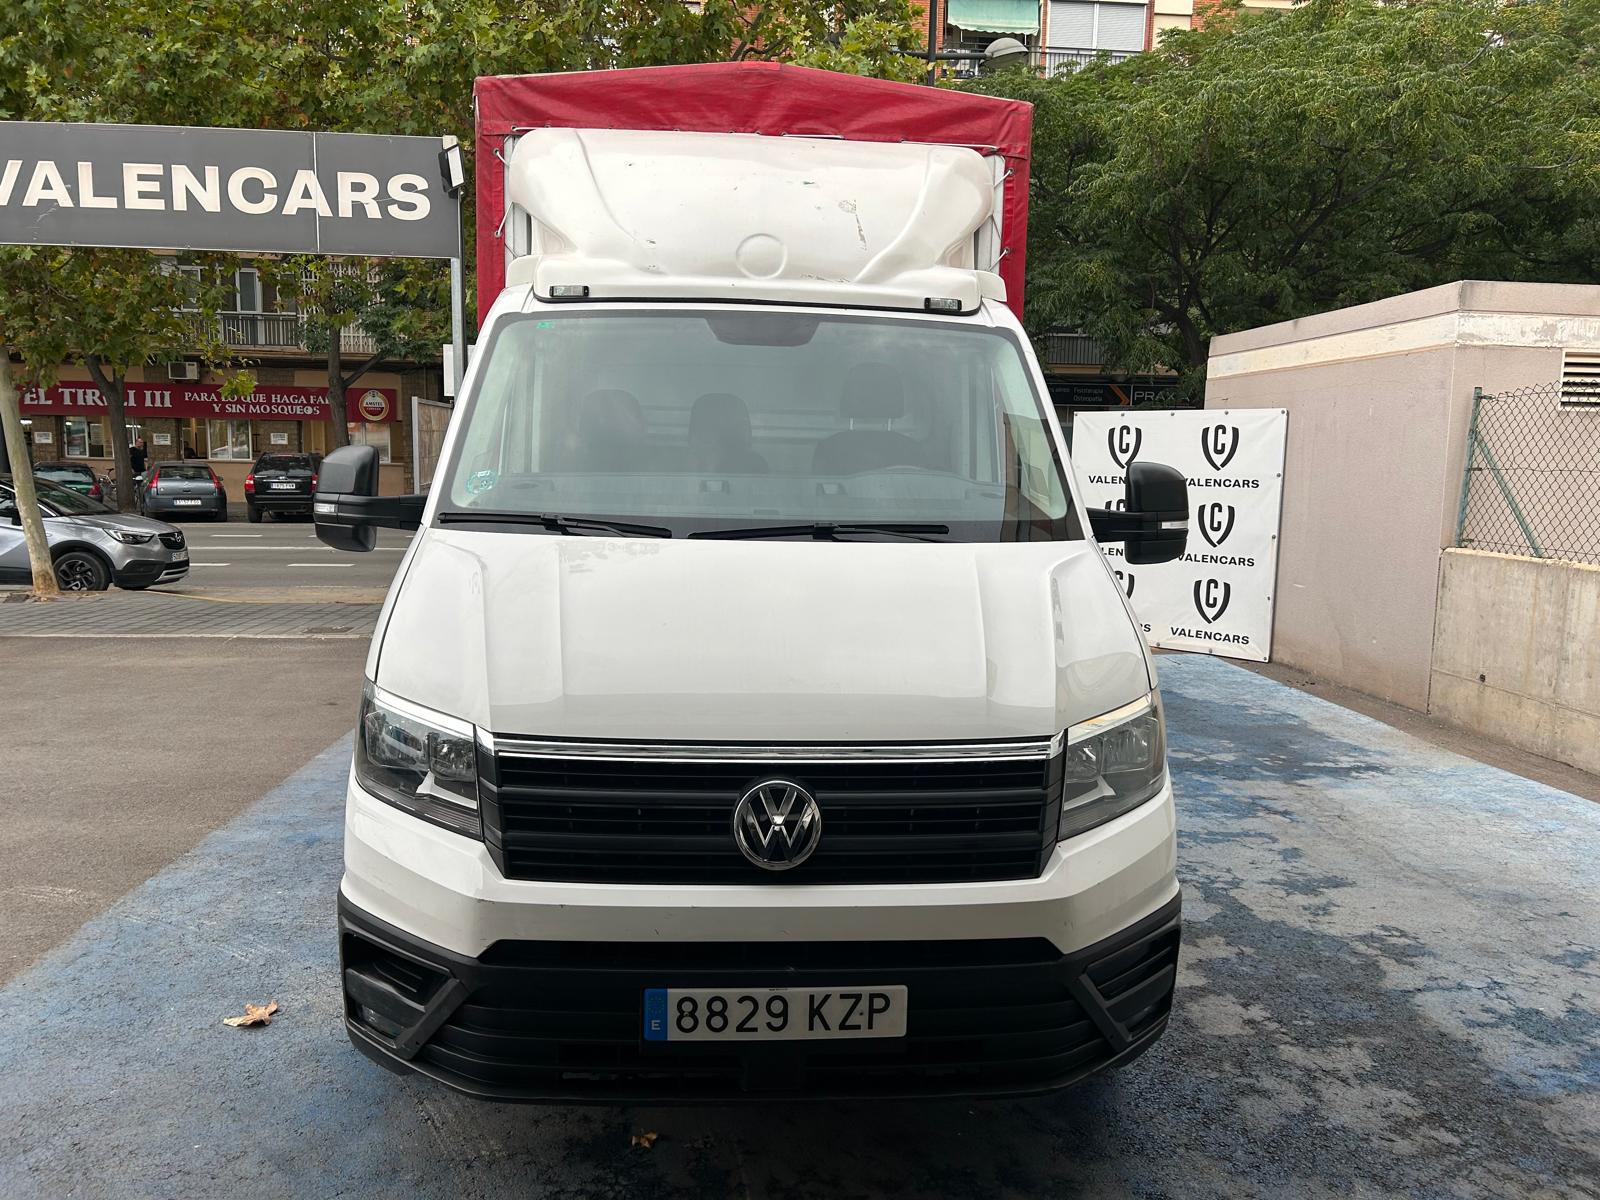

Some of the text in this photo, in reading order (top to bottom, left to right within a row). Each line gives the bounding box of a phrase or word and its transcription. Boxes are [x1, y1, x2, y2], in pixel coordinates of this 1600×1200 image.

[23, 387, 173, 408] EL TIRI III
[184, 392, 217, 402] PARA
[240, 394, 267, 404] QUE
[271, 394, 307, 404] HAGA
[212, 403, 222, 413] Y
[225, 404, 246, 413] SIN
[1088, 475, 1126, 485] VALEN
[1178, 553, 1255, 567] VALENCARS
[1170, 627, 1250, 645] VALENCARS
[650, 992, 891, 1033] E 8829 KZP
